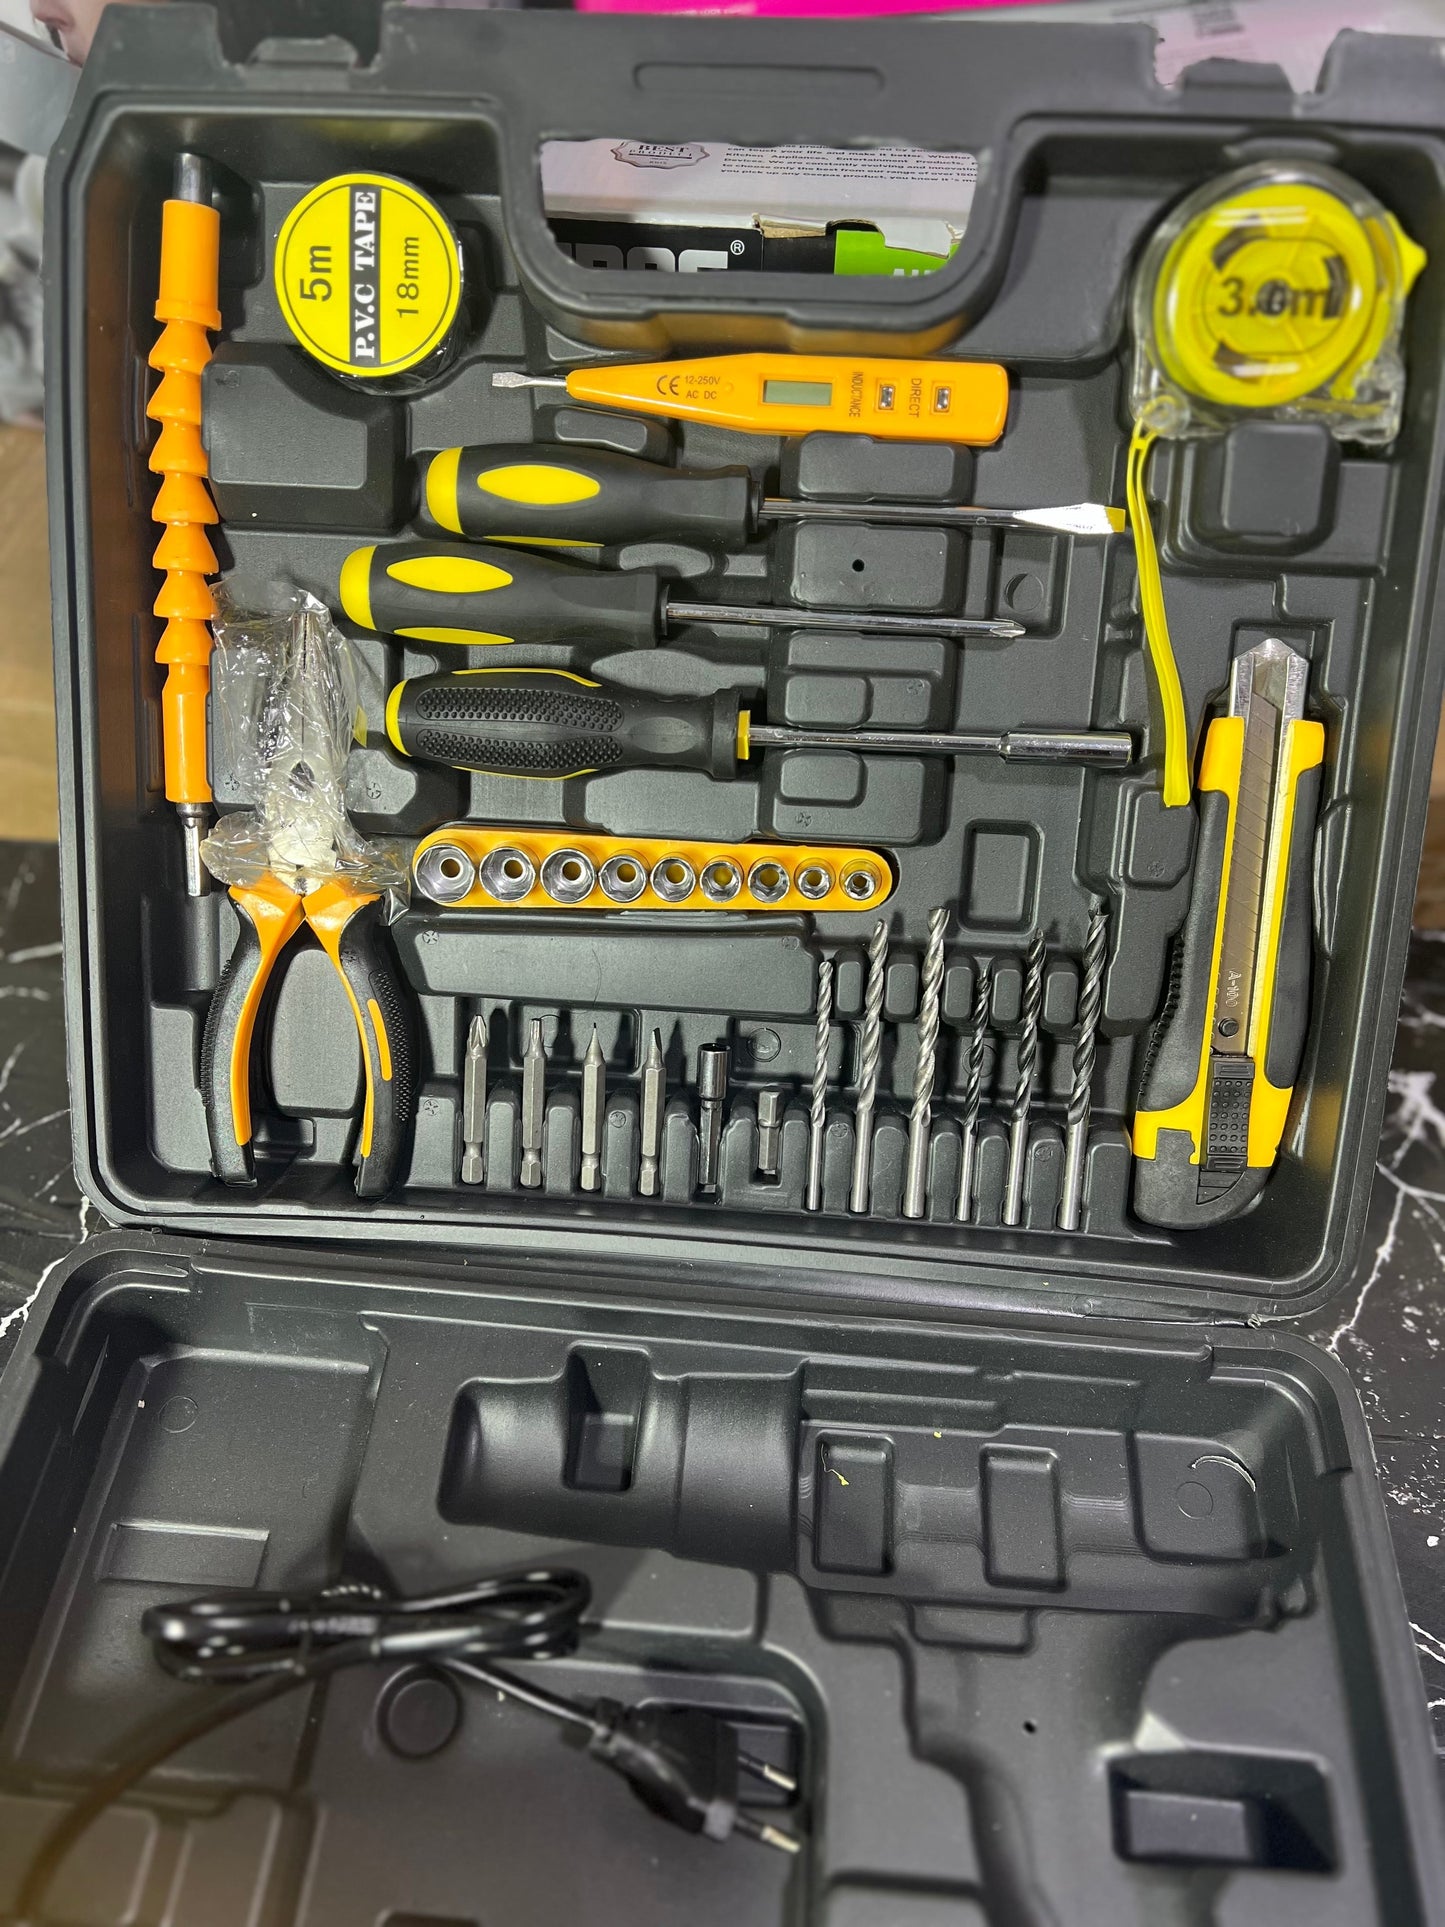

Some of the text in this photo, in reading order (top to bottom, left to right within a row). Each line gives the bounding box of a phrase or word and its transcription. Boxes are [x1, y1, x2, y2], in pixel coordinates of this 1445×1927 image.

[300, 245, 332, 302] 5m
[354, 191, 376, 358] P.V.C TAPE
[396, 236, 419, 318] 18mm
[656, 374, 680, 396] CE
[684, 375, 721, 385] 12-250V
[686, 390, 717, 400] AC DC
[848, 371, 864, 418] INDUCTANCE
[909, 378, 922, 418] DIRECT
